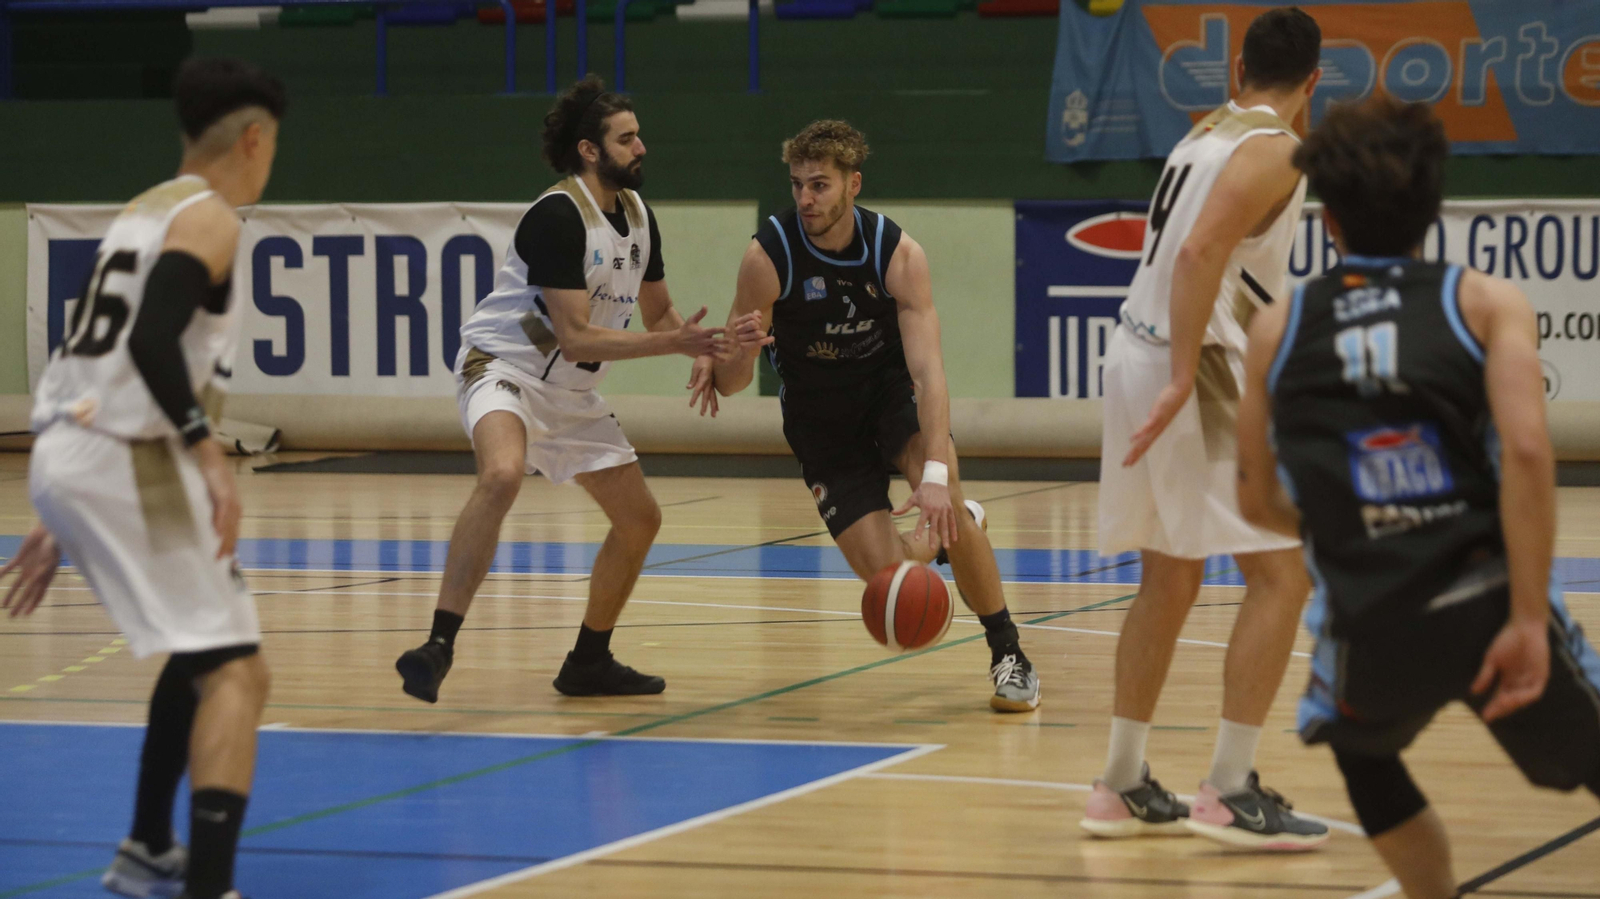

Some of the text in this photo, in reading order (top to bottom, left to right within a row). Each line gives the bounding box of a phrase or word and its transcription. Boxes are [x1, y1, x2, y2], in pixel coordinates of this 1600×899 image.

[1159, 13, 1600, 138] dporte
[807, 292, 822, 300] EBA
[1334, 321, 1398, 381] 11
